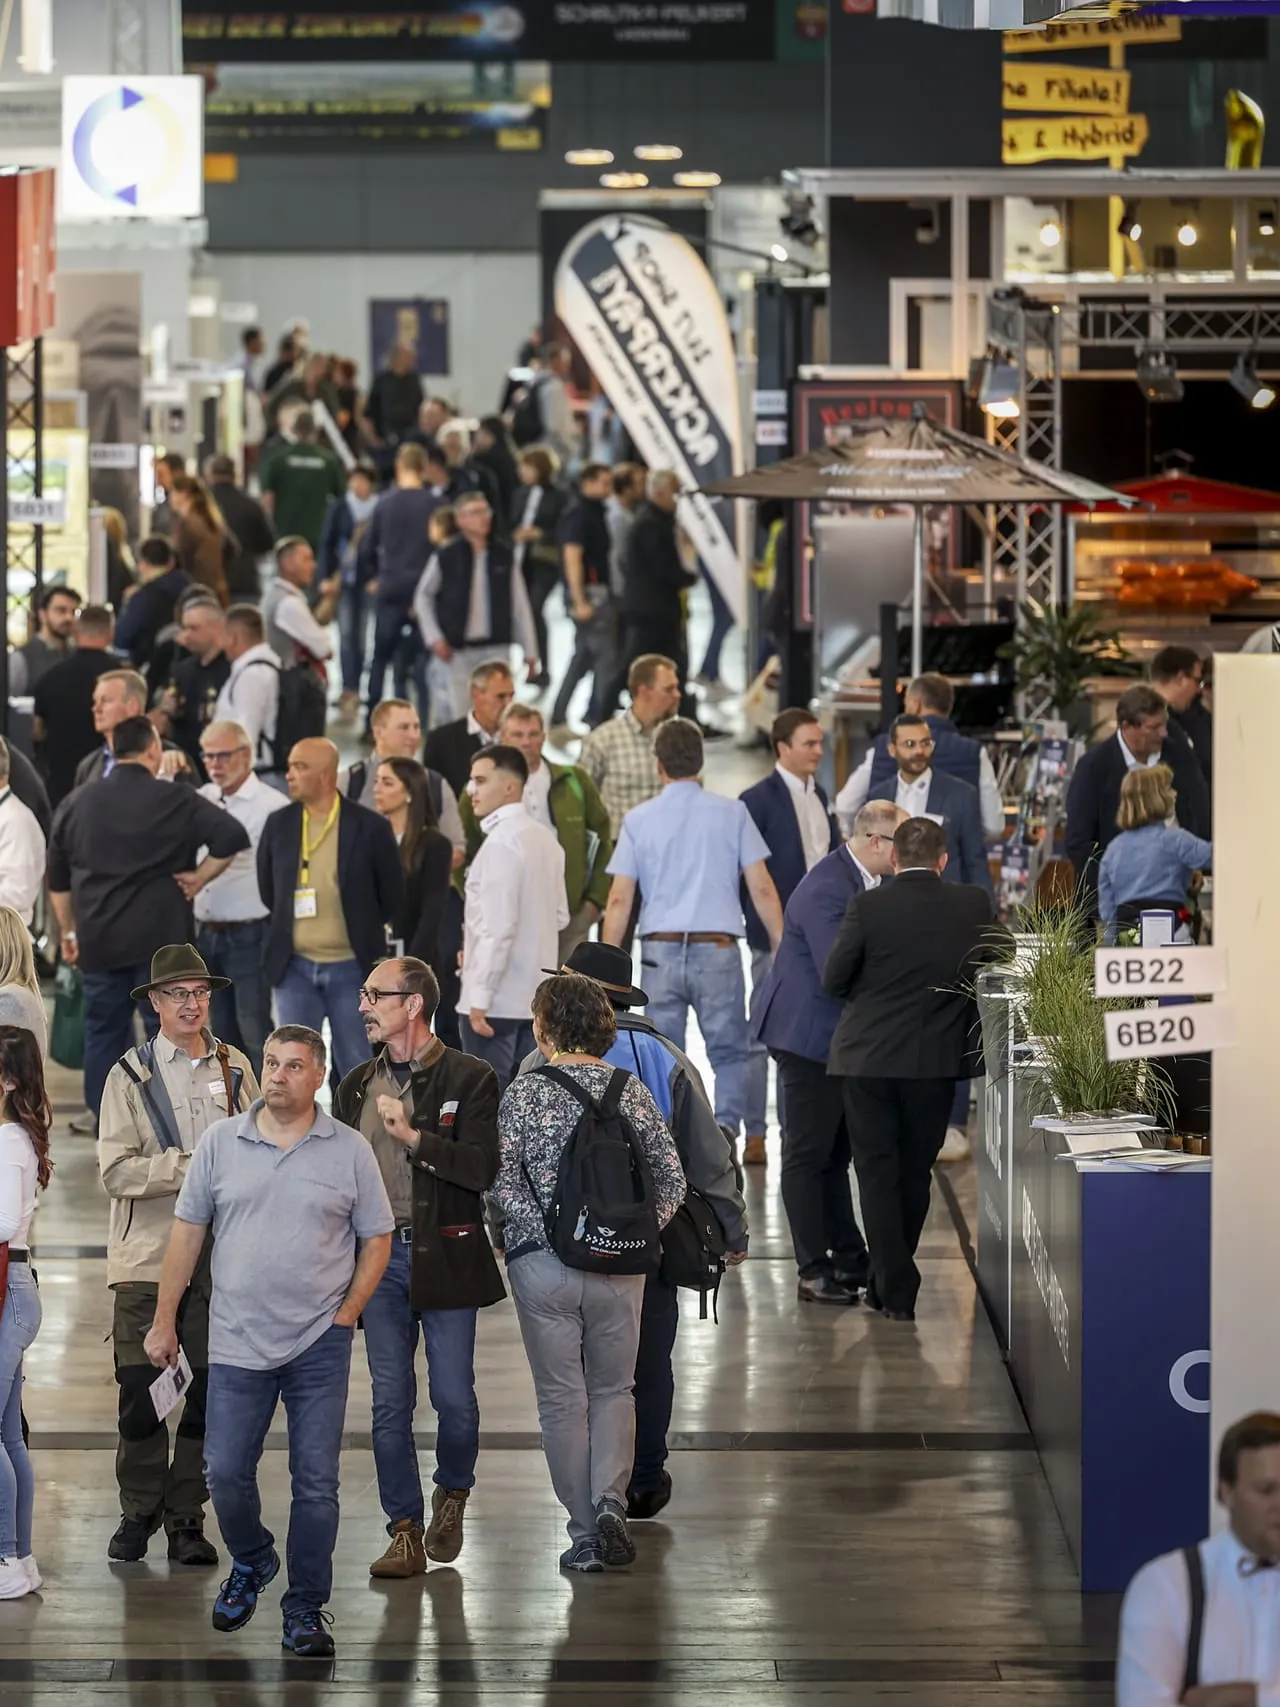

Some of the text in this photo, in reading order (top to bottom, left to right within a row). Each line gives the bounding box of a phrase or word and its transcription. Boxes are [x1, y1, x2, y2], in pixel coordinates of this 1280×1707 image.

[1063, 121, 1135, 151] Hybrid
[1106, 958, 1185, 984] 6B22
[1117, 1016, 1195, 1047] 6B20
